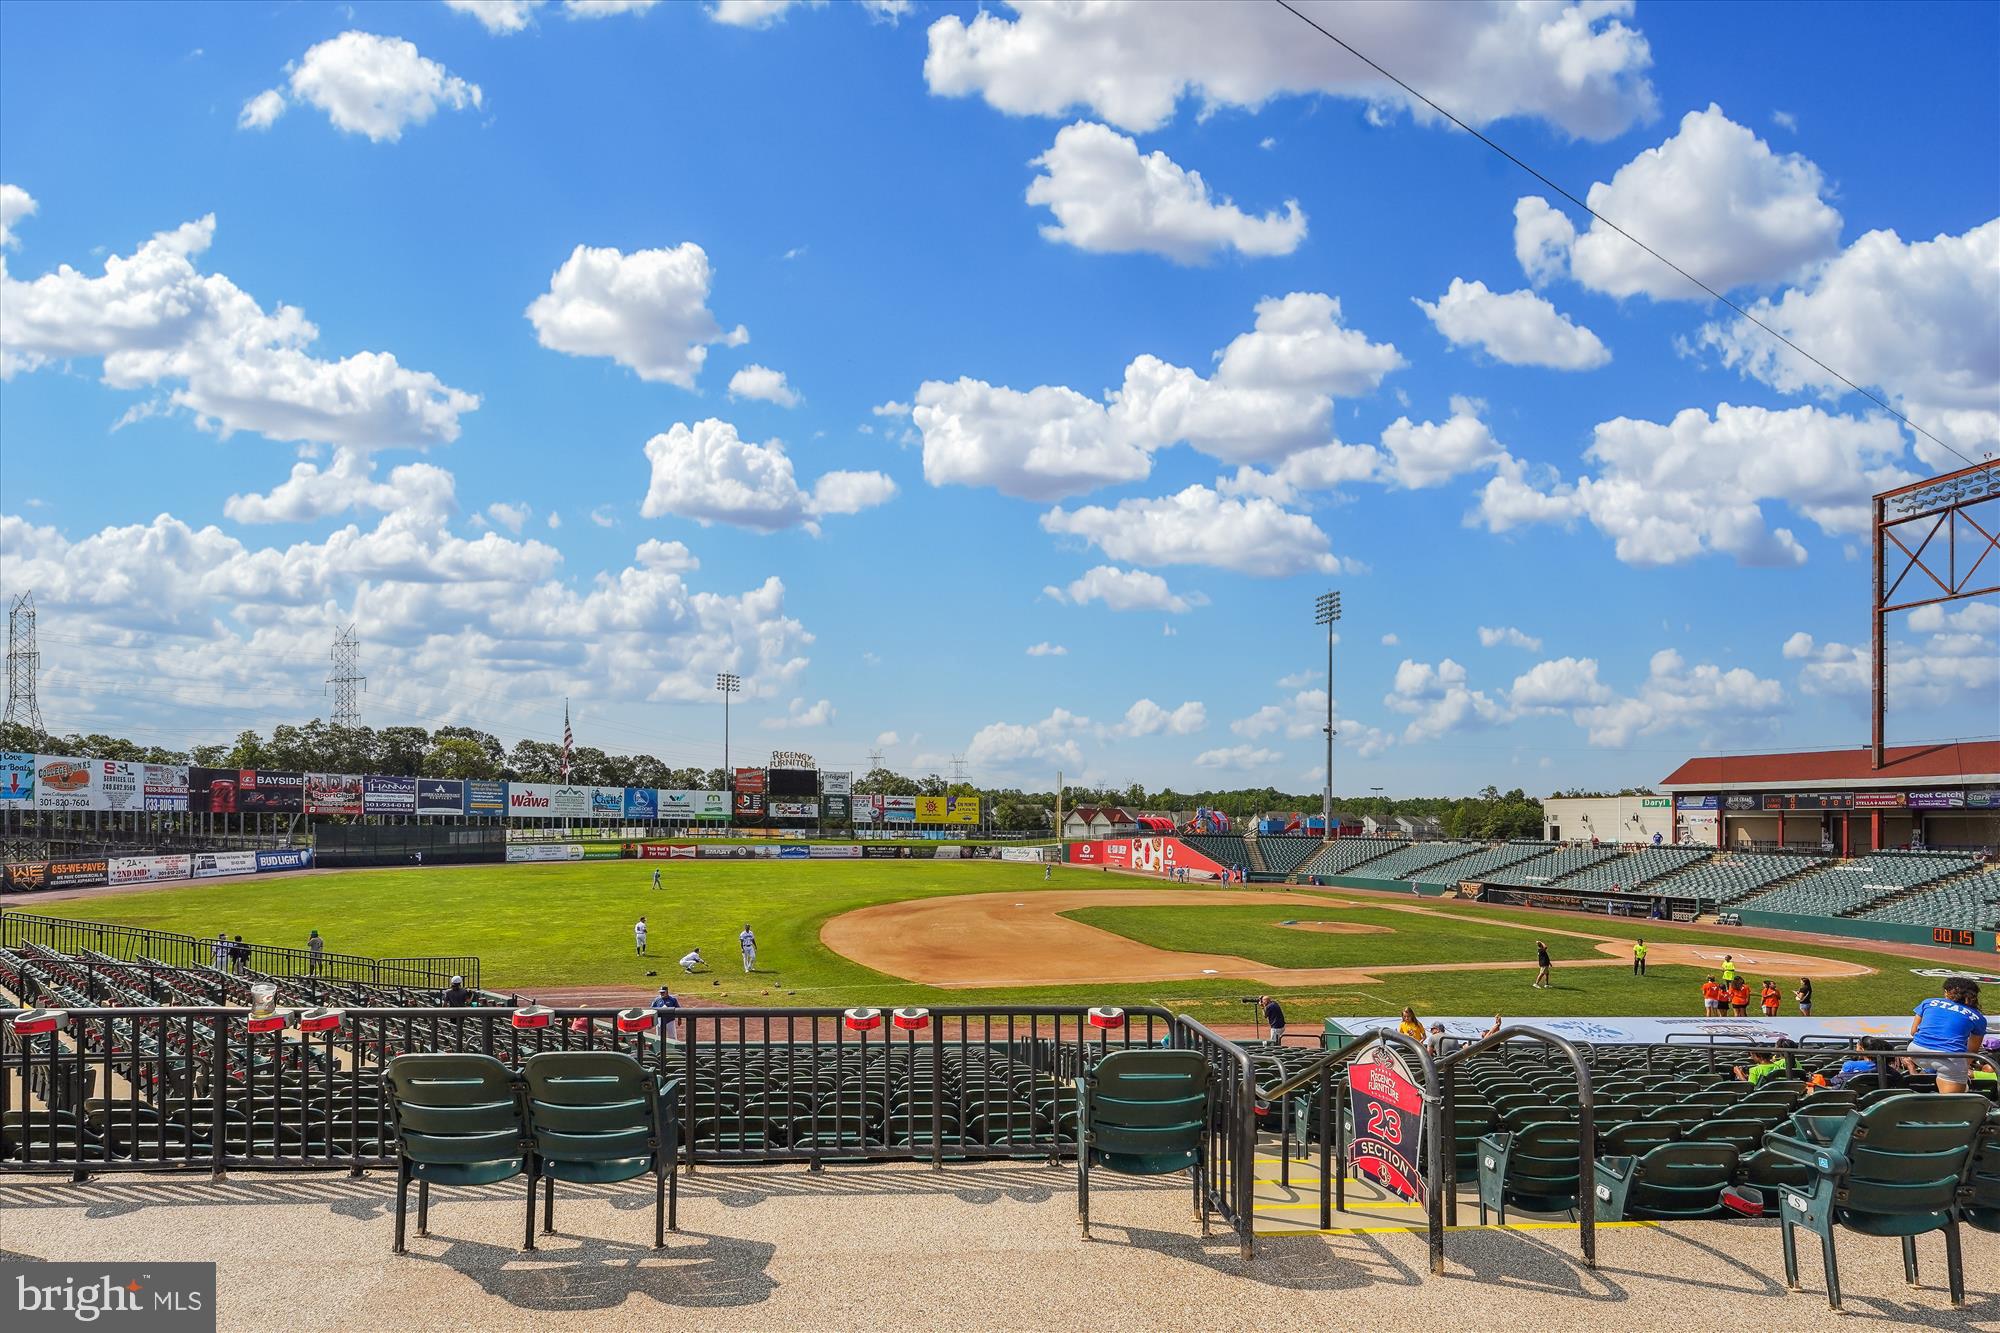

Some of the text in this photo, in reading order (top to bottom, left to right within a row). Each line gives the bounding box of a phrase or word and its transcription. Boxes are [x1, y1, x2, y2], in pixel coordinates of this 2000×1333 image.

[4, 752, 22, 761] Cove
[773, 750, 813, 761] REGENCY
[8, 763, 31, 771] Boats
[770, 759, 816, 769] FURNITURE
[39, 764, 69, 778] COLLEGE
[257, 777, 303, 785] BAYSIDE
[511, 794, 549, 807] Wawa
[595, 793, 622, 804] Castle
[1936, 791, 1964, 800] Catch!
[1967, 793, 1990, 801] Stark
[40, 799, 90, 807] 301-820-7604
[145, 798, 188, 811] 833-BUG-MIKE
[1644, 799, 1666, 807] Daryl
[260, 855, 299, 866] BUD LIGHT
[117, 870, 132, 878] 2ND
[1959, 930, 1972, 945] 15
[1929, 999, 1980, 1021] STAFF
[1370, 1070, 1396, 1088] REGENCY
[1368, 1080, 1400, 1102] FURNITURE
[1367, 1102, 1402, 1145] 23
[1361, 1142, 1409, 1177] SECTION
[1793, 1197, 1803, 1208] S
